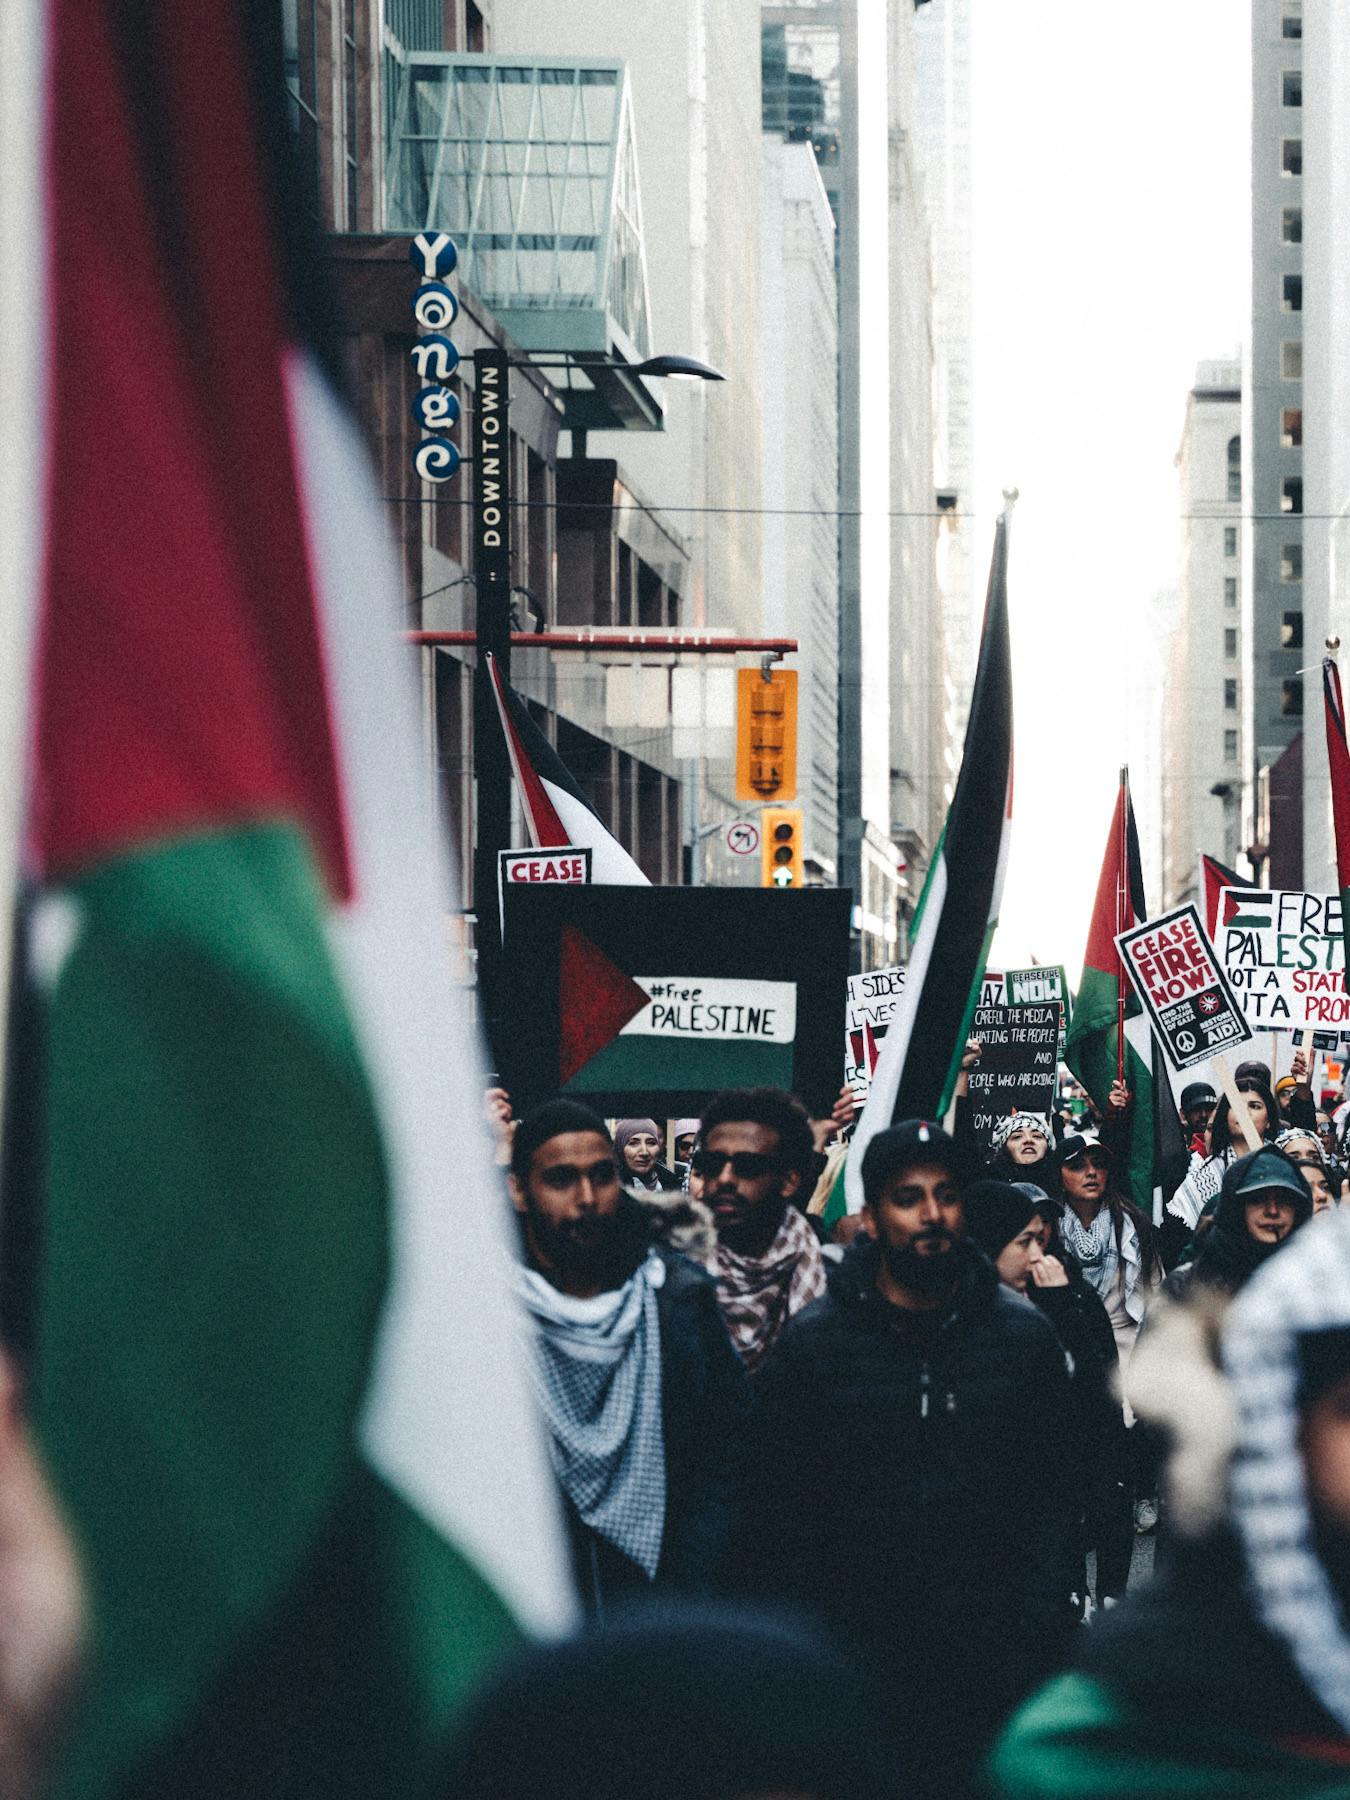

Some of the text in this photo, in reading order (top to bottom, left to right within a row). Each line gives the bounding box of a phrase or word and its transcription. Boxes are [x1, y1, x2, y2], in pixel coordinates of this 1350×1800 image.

[411, 233, 456, 484] Yonge
[482, 367, 501, 547] DOWNTOWN
[511, 859, 583, 882] CEASE
[1278, 893, 1344, 936] FRE
[1132, 919, 1195, 961] CEASE
[1138, 938, 1206, 989] FIRE
[862, 971, 906, 998] SIDES
[1012, 969, 1059, 982] CEASEFIRE
[1151, 964, 1216, 1008] NOW!
[1264, 971, 1279, 988] A
[650, 983, 703, 1002] #Free
[979, 984, 1007, 1007] AZ
[1013, 979, 1062, 1003] NOW
[975, 1008, 1054, 1025] CAREFUL THE MEDIA
[1160, 1001, 1191, 1020] END THE
[1164, 1008, 1194, 1026] BLOCKADE
[1270, 995, 1290, 1018] A
[651, 1004, 776, 1035] PALESTINE
[1167, 1013, 1197, 1031] OF GAZA
[1200, 1010, 1233, 1029] RESTORE
[1011, 1028, 1027, 1042] THE
[1027, 1028, 1056, 1043] PEOPLE
[1207, 1021, 1239, 1046] AID!
[1034, 1051, 1053, 1065] AND
[997, 1073, 1016, 1087] WHO
[1016, 1073, 1032, 1085] ARE
[1032, 1072, 1055, 1086] DOING
